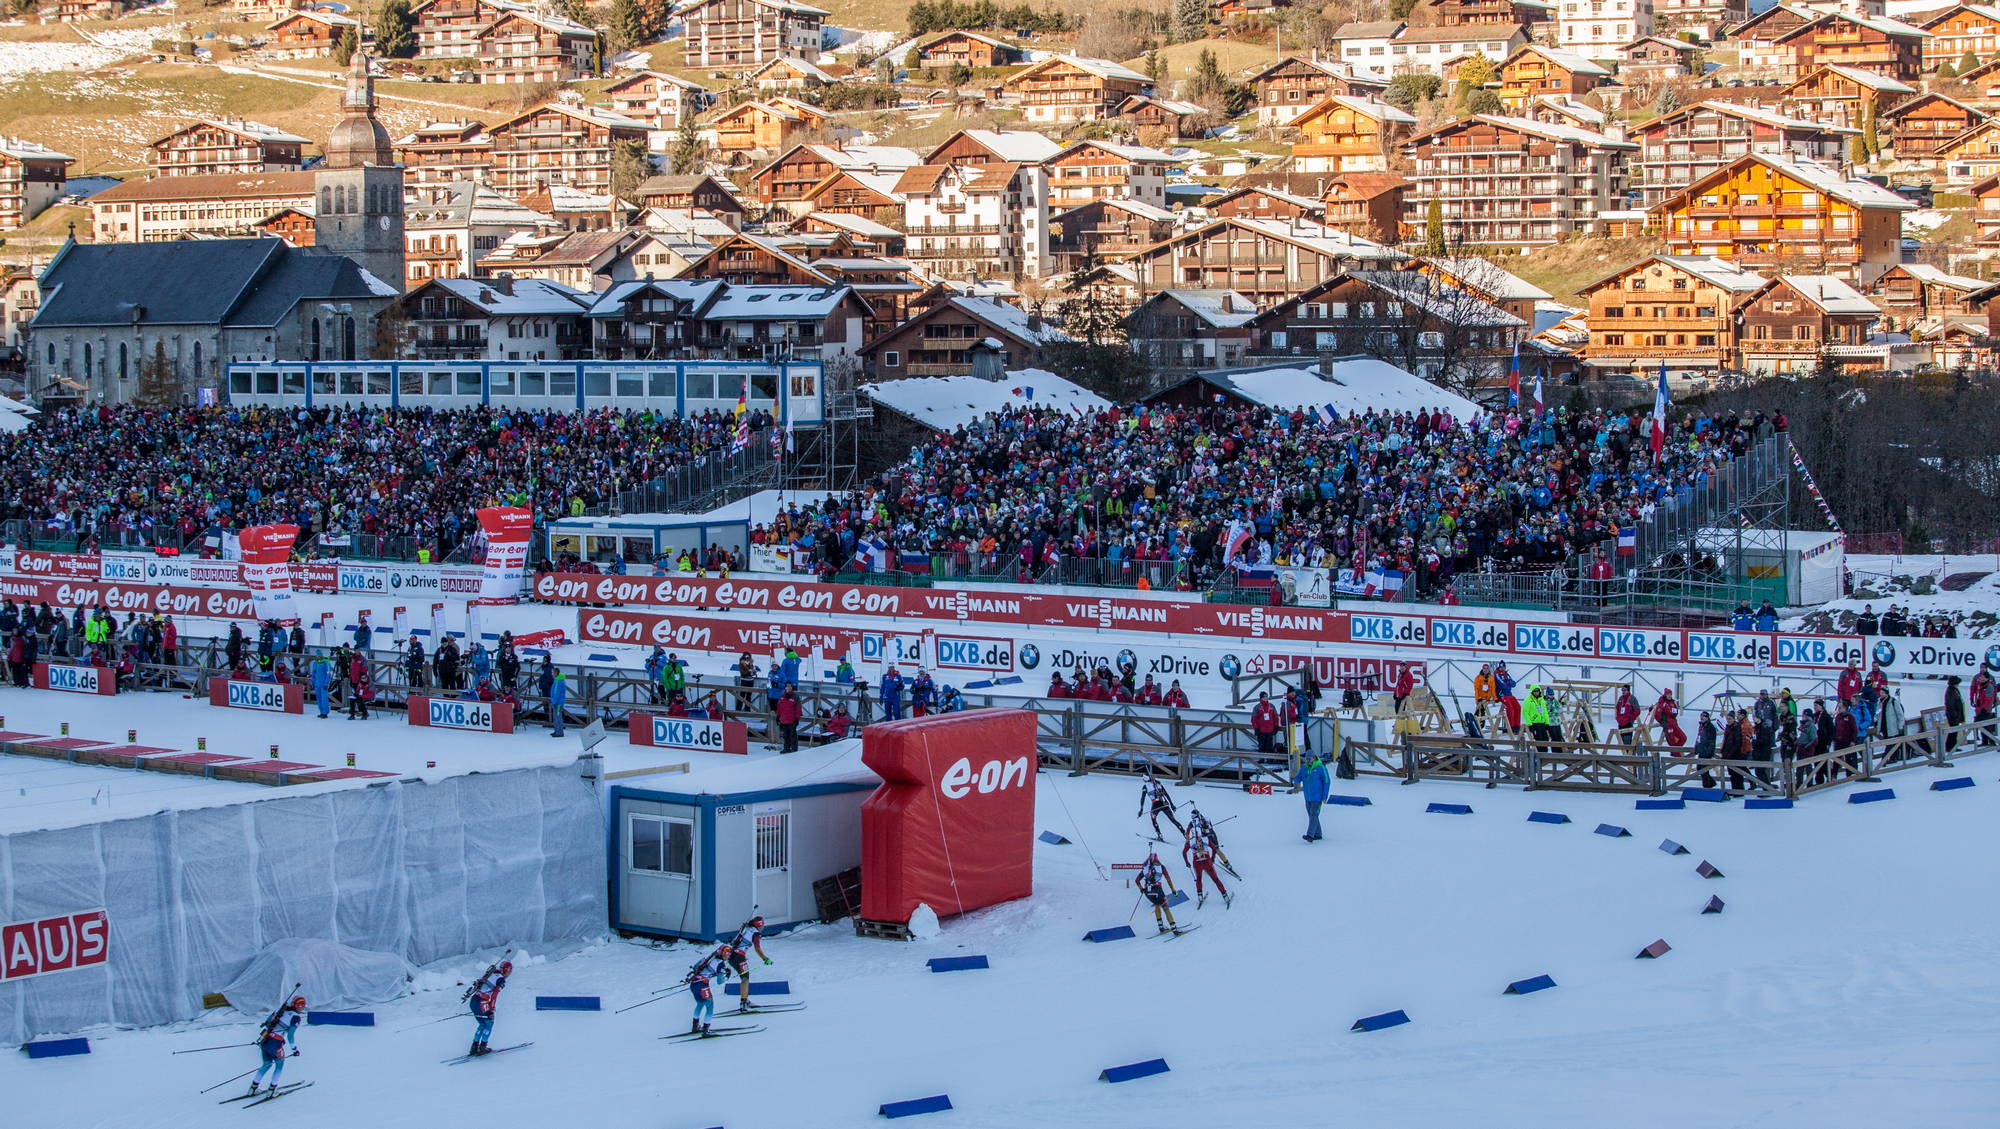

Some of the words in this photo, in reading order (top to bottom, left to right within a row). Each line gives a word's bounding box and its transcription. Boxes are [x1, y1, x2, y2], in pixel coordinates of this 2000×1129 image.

[105, 563, 140, 578] DKB.de
[161, 565, 188, 577] xDrive
[191, 569, 238, 581] BAUHAUS
[289, 568, 334, 584] VIESSMANN
[341, 574, 383, 589] DKB.de
[405, 575, 438, 588] xDrive
[441, 580, 481, 592] BAUHA
[925, 591, 1020, 619] VIESSMANN
[1066, 599, 1167, 628] VIESSMANN
[1216, 607, 1323, 637] VIESSMANN
[1351, 617, 1425, 641] DKB.de
[1432, 622, 1508, 647] DKB.de
[1516, 628, 1594, 652] DKB.de
[1600, 632, 1680, 656] DKB.de
[939, 641, 1009, 666] DKB.de
[1689, 636, 1770, 661] DKB.de
[1778, 640, 1862, 664] DKB.de
[1909, 645, 1976, 667] xDrive
[1149, 655, 1209, 675] xDrive
[50, 667, 97, 689] DKB.de
[229, 684, 283, 707] DKB.de
[430, 702, 490, 726] DKB.de
[654, 720, 722, 746] DKB.de
[717, 806, 745, 814] COFICIEL
